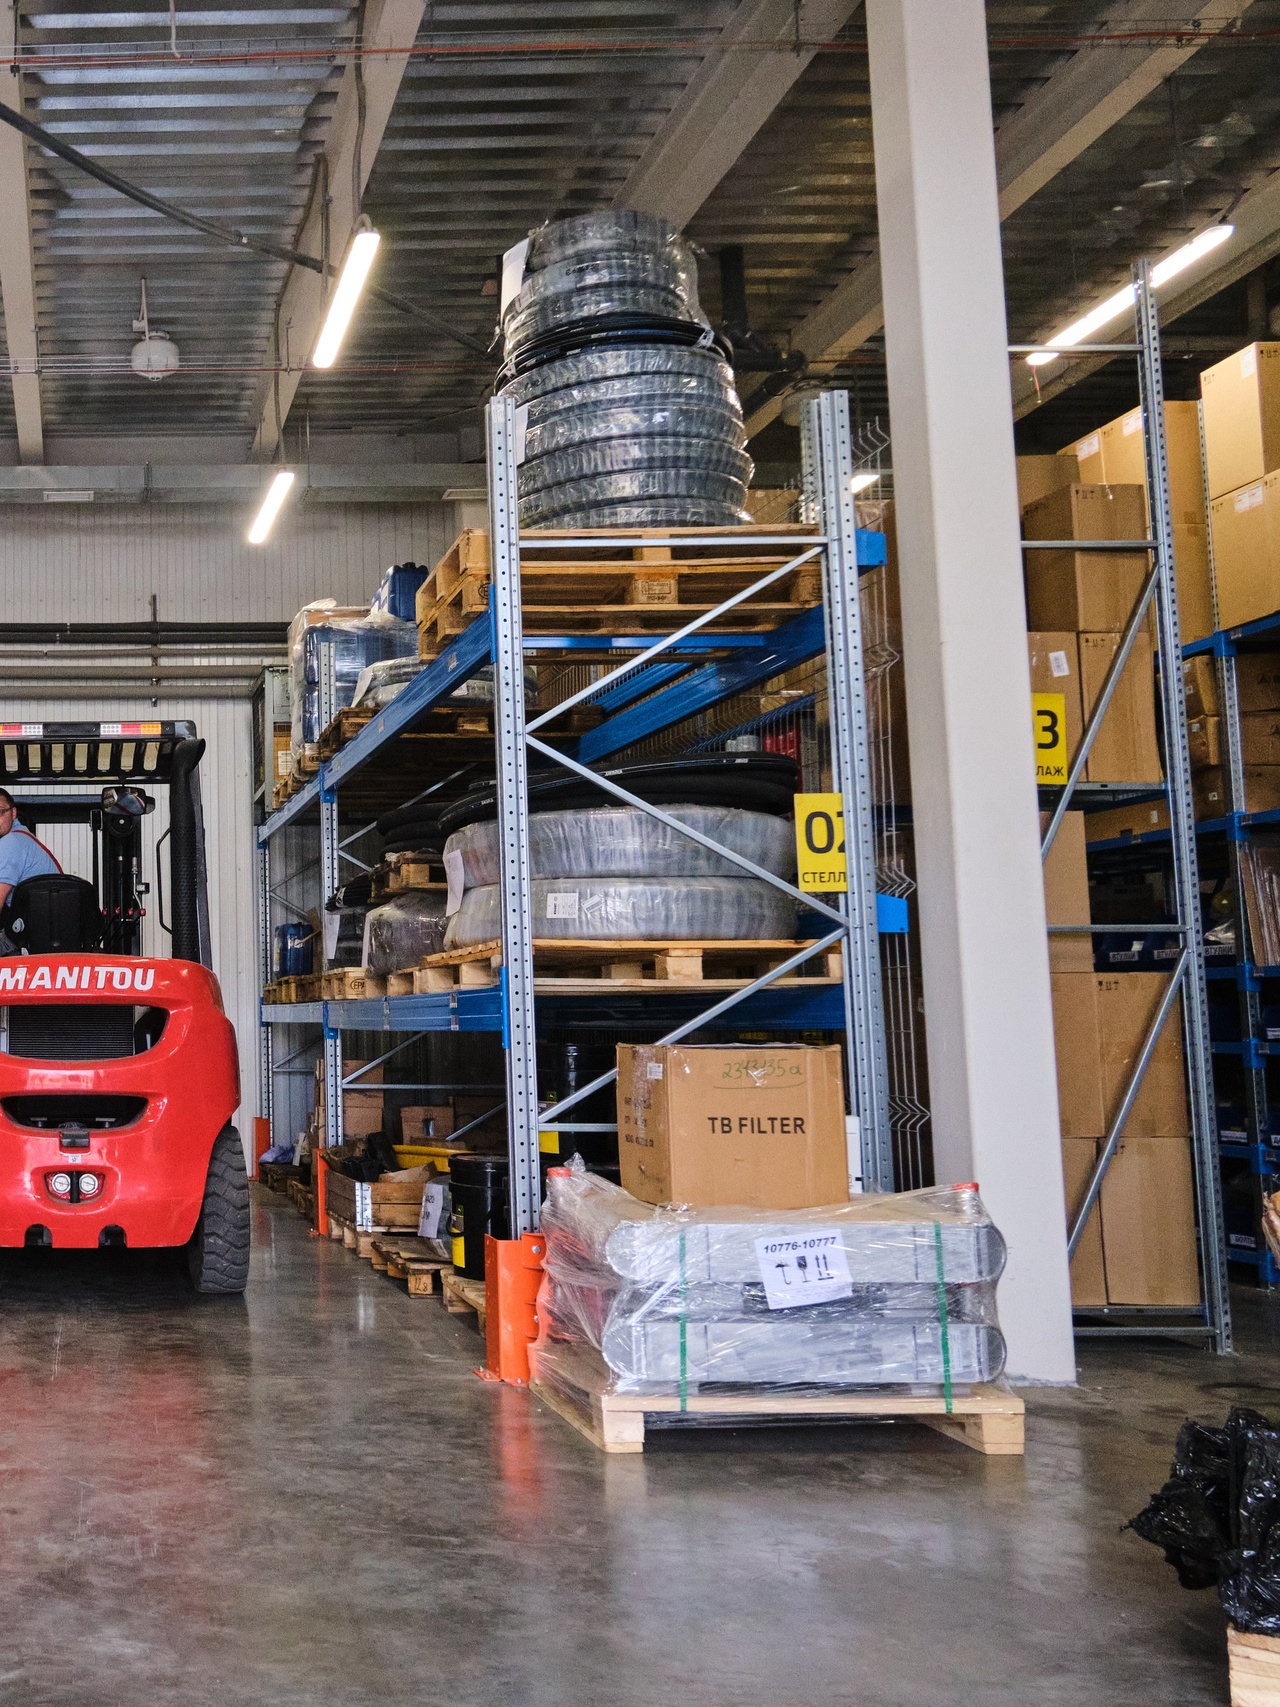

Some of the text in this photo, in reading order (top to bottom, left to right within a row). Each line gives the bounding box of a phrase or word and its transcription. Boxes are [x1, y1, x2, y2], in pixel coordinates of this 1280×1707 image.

[1036, 709, 1060, 749] 3
[802, 871, 847, 884] СТЕЛЛ
[708, 1117, 806, 1134] TB FILTER
[763, 1236, 837, 1254] 10776-10777
